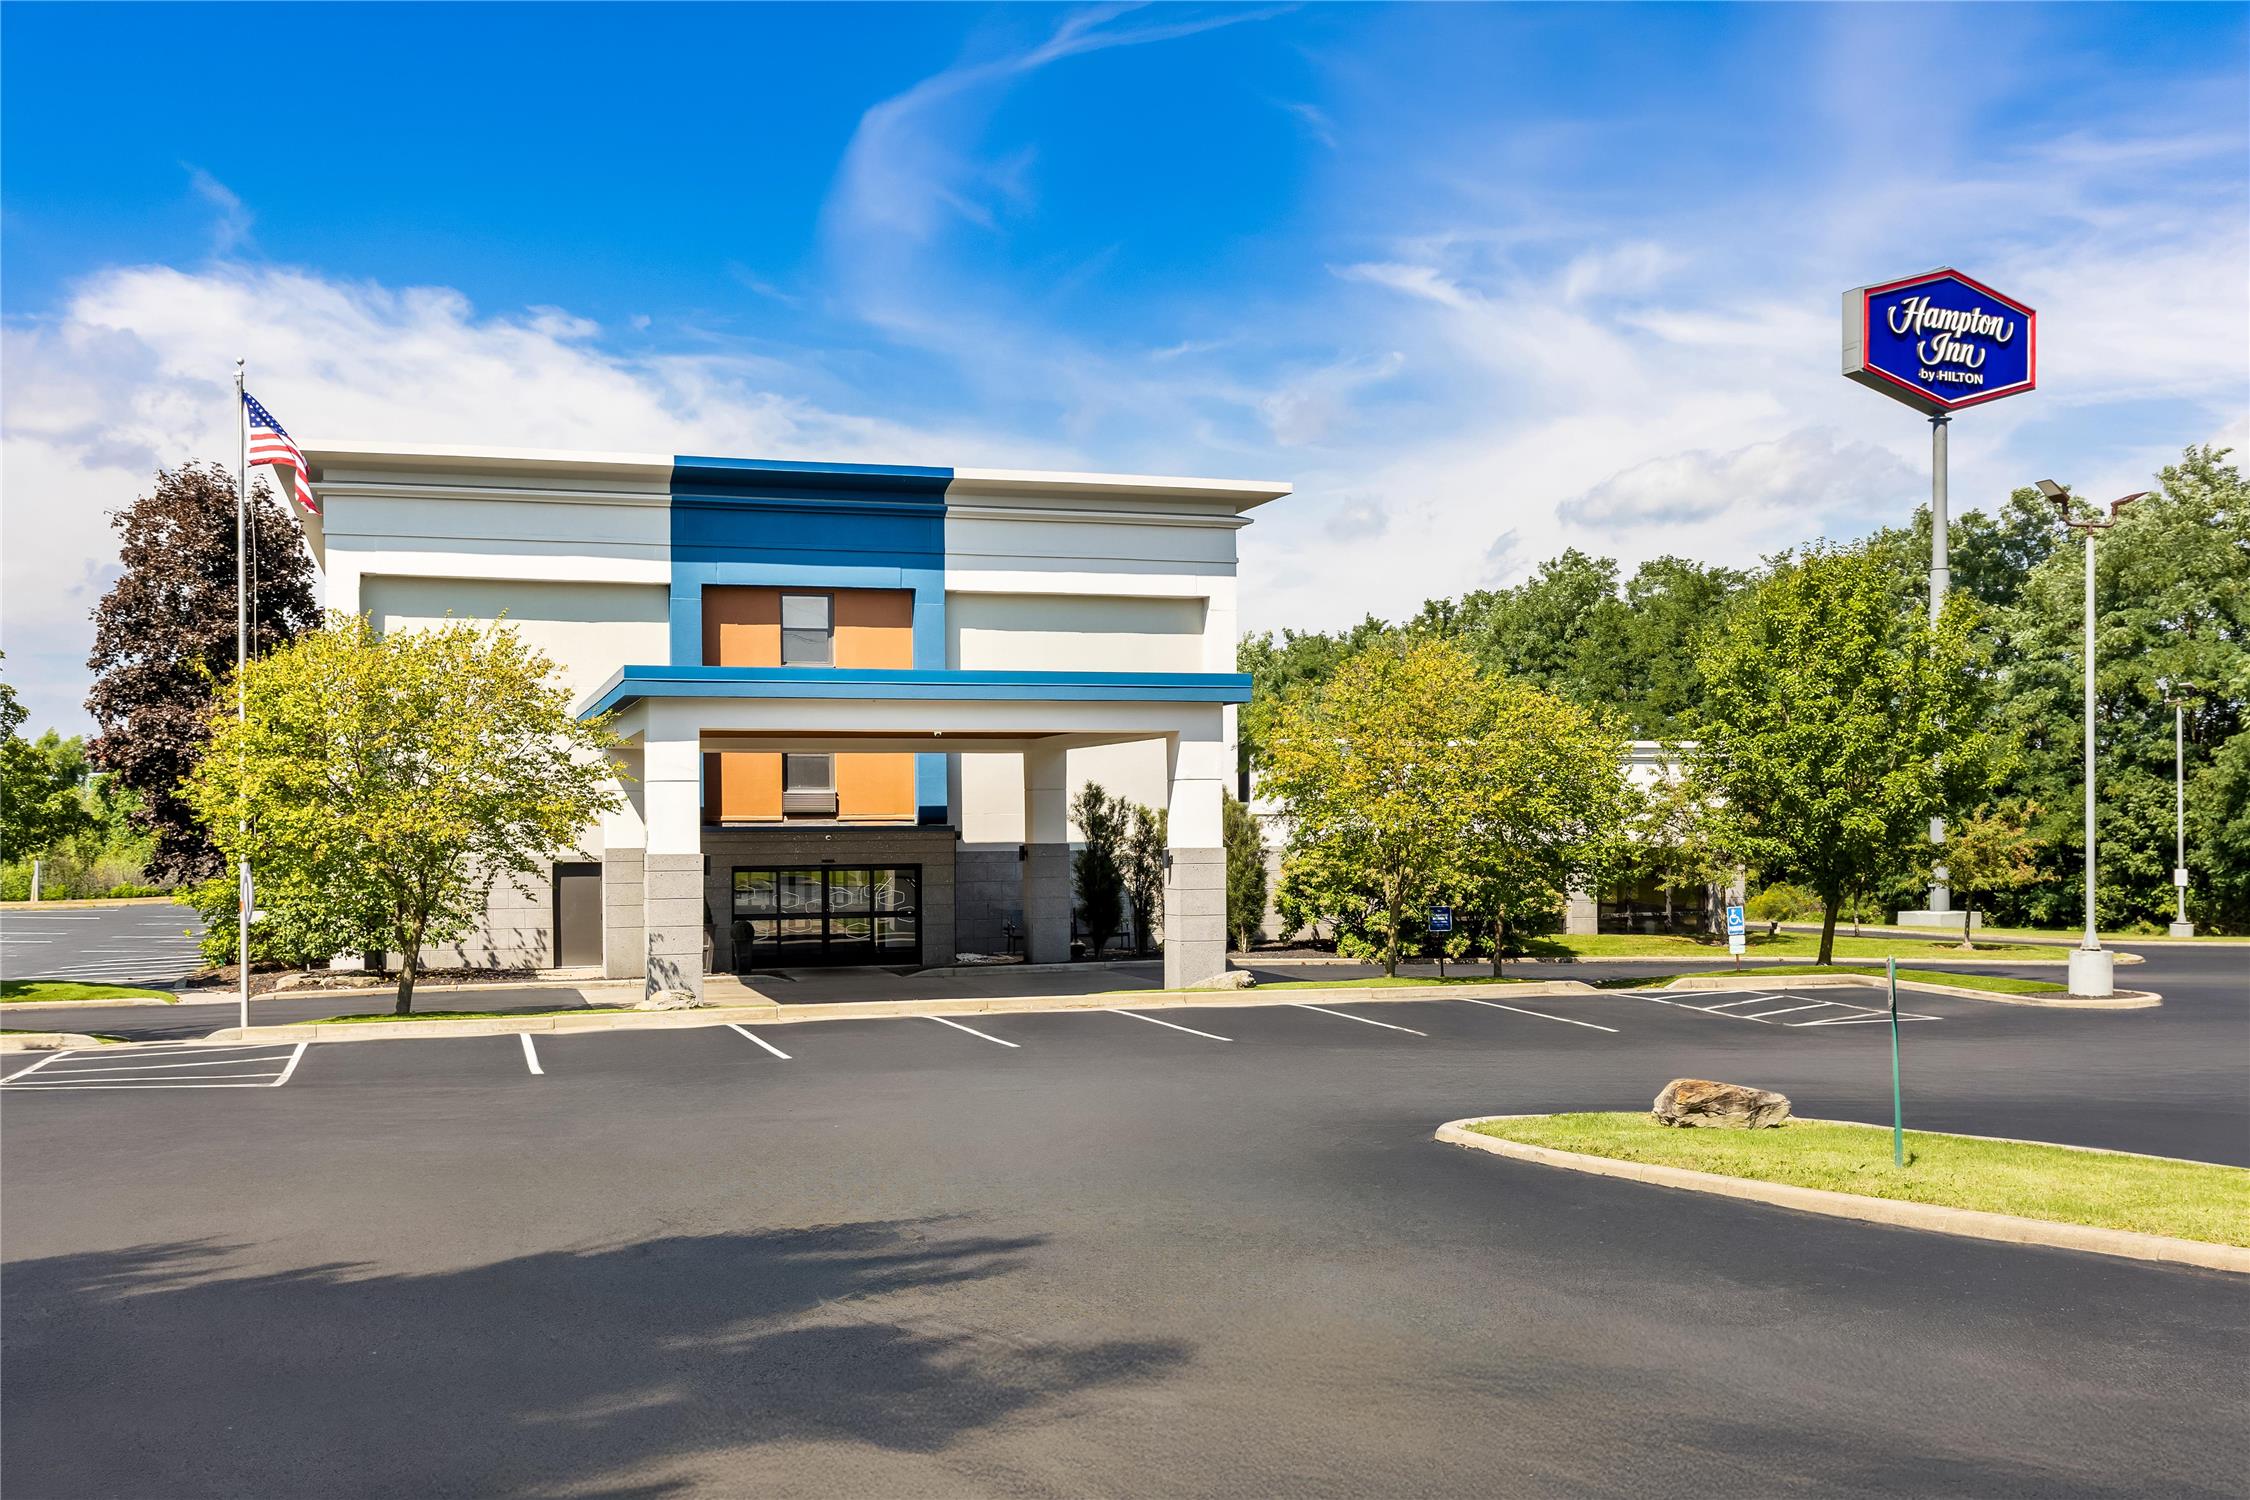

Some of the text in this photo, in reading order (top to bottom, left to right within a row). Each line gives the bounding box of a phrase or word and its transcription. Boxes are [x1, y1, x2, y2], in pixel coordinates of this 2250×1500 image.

[1888, 296, 2014, 342] Hampton
[1917, 332, 1986, 368] Inn
[1920, 368, 1983, 384] by HILTON
